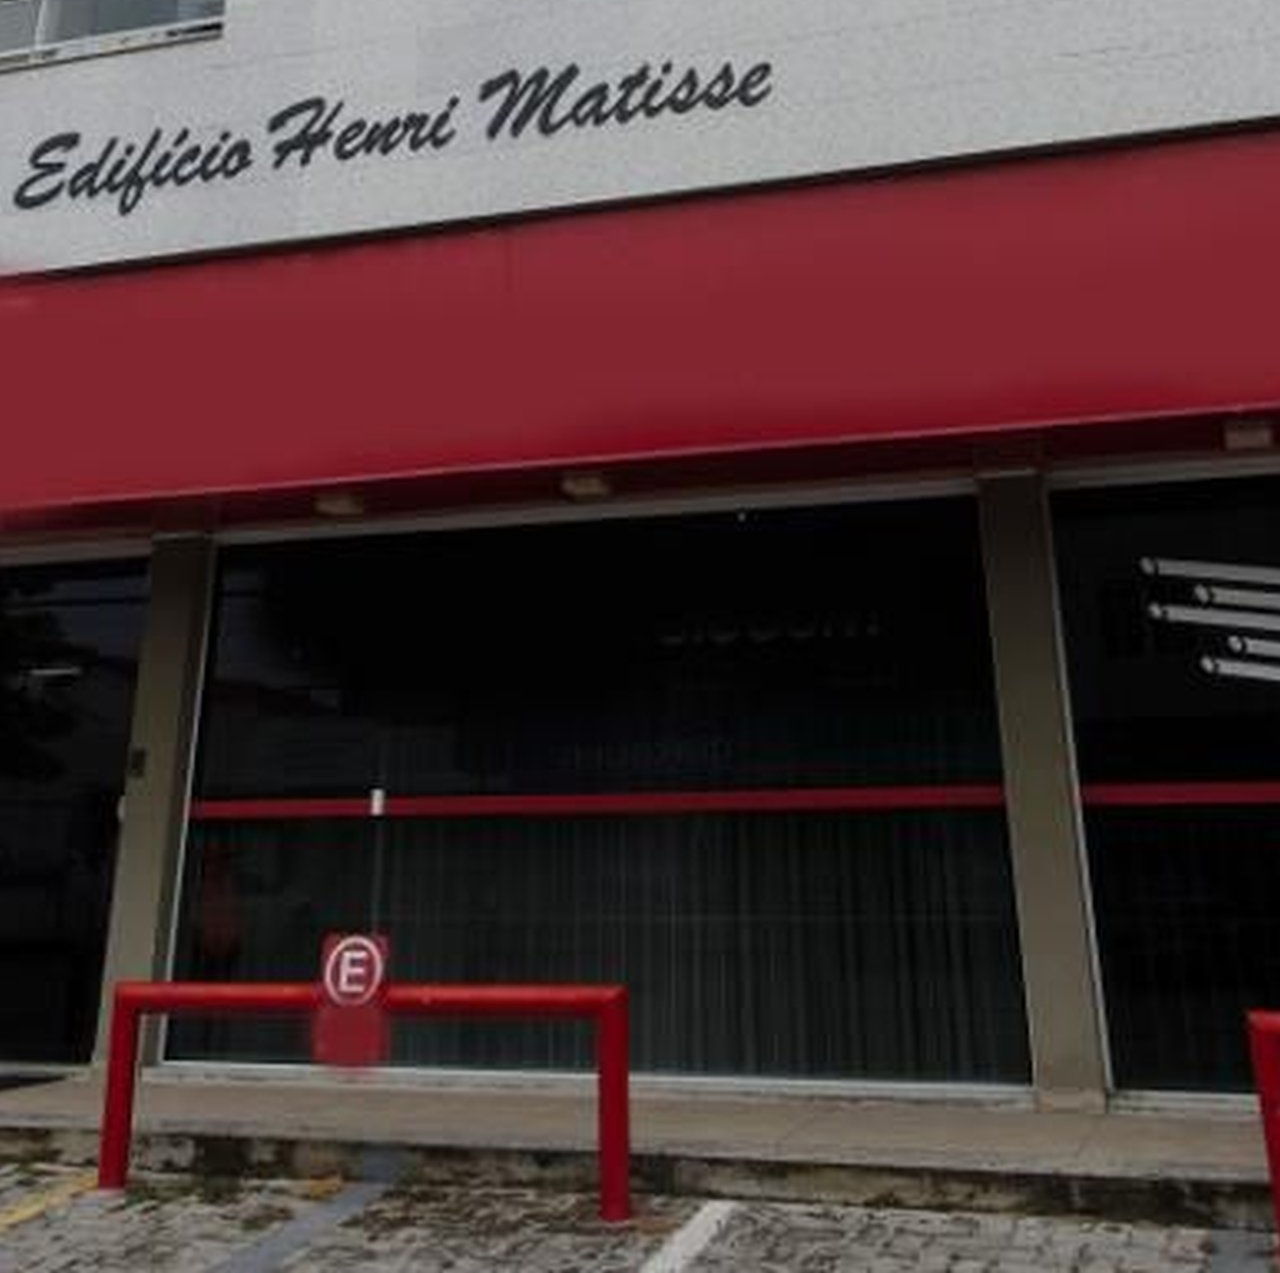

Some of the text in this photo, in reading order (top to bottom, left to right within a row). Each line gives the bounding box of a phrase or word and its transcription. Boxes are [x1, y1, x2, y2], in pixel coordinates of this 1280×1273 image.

[12, 61, 774, 216] Edifício Henri Matisse
[338, 950, 369, 994] E
